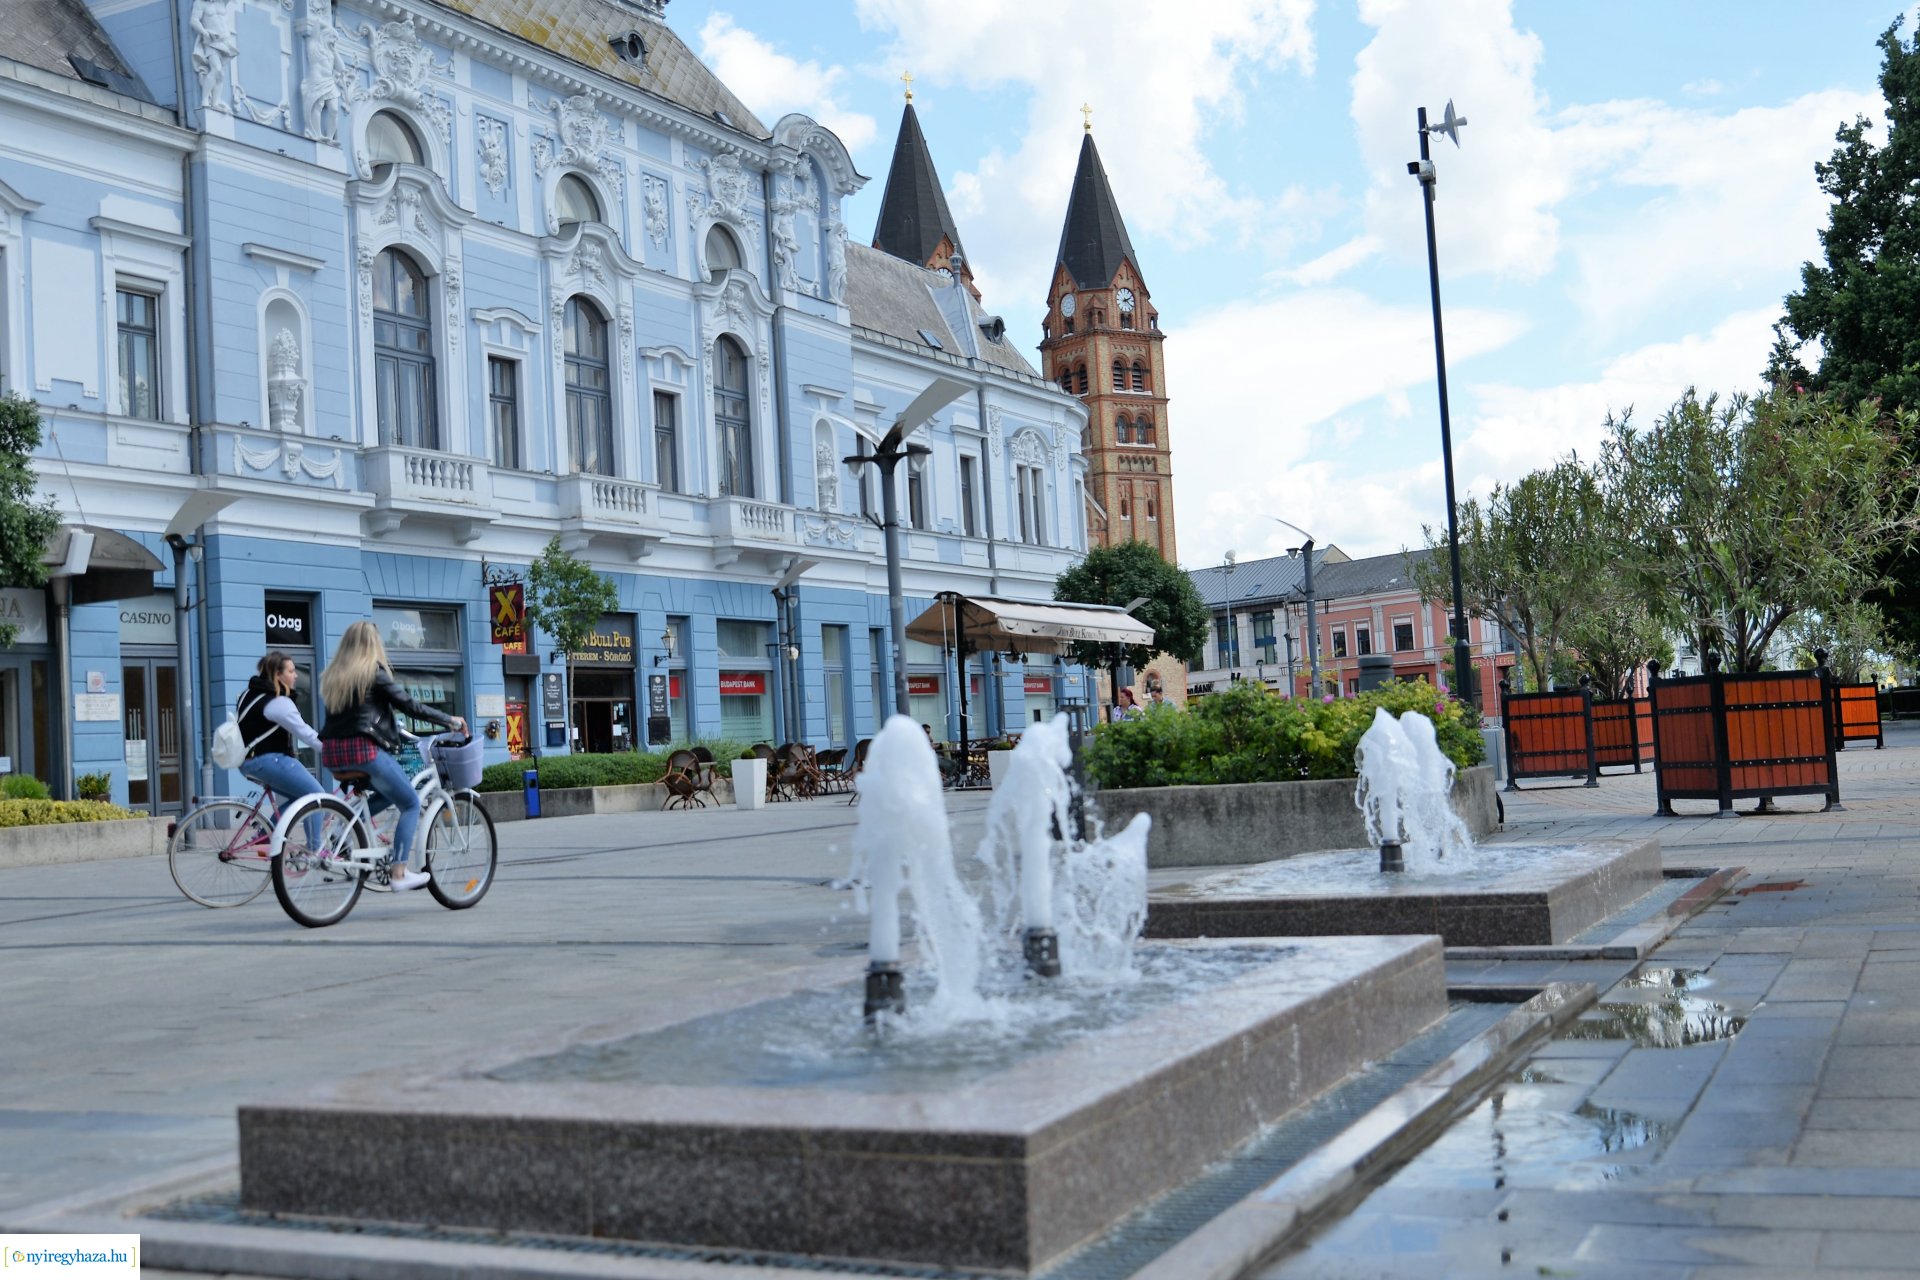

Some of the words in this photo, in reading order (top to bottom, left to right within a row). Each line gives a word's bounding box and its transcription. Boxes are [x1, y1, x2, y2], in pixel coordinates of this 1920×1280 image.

[495, 590, 518, 624] X
[119, 611, 172, 625] CASINO
[266, 613, 277, 628] O
[278, 614, 302, 632] bag
[494, 624, 521, 638] CAFÉ
[589, 630, 612, 647] BULL
[612, 631, 631, 648] PUB
